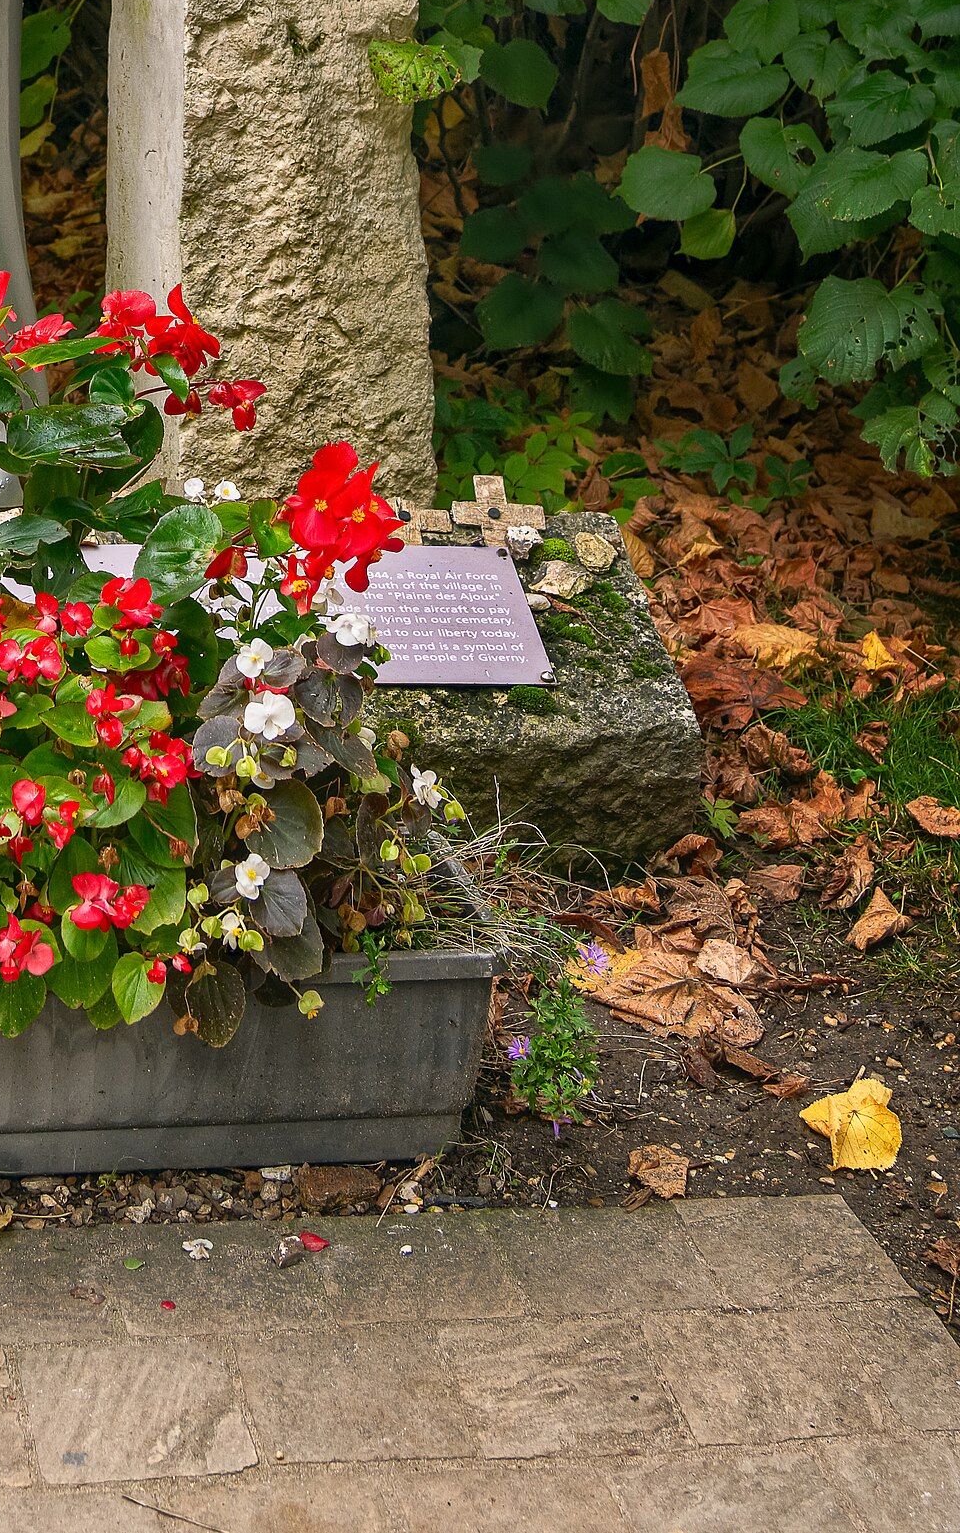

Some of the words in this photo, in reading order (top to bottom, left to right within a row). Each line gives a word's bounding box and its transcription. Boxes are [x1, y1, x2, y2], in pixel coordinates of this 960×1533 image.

[368, 571, 393, 581] 944,
[407, 571, 441, 582] Royal
[445, 572, 462, 580] Air
[466, 572, 499, 581] Force
[369, 582, 399, 590] outh
[403, 582, 415, 590] of
[419, 582, 440, 590] the
[443, 582, 487, 592] village,
[490, 582, 503, 591] in
[362, 592, 384, 600] the
[435, 591, 457, 600] des
[364, 604, 396, 613] from
[399, 604, 420, 613] the
[423, 605, 469, 614] aircraft
[471, 606, 486, 614] to
[488, 607, 510, 616] pay
[380, 614, 411, 625] lying
[414, 615, 428, 624] in
[430, 616, 452, 624] our
[455, 616, 515, 626] cemetary.
[394, 628, 409, 637] to
[437, 628, 478, 639] liberty
[481, 629, 520, 639] today.
[383, 642, 408, 650] rew
[412, 641, 436, 650] and
[439, 641, 449, 650] is
[452, 643, 460, 651] a
[463, 642, 508, 652] symbol
[511, 643, 525, 651] of
[390, 652, 410, 661] the
[413, 652, 458, 663] people
[461, 653, 475, 661] of
[478, 653, 529, 663] Giverny.
